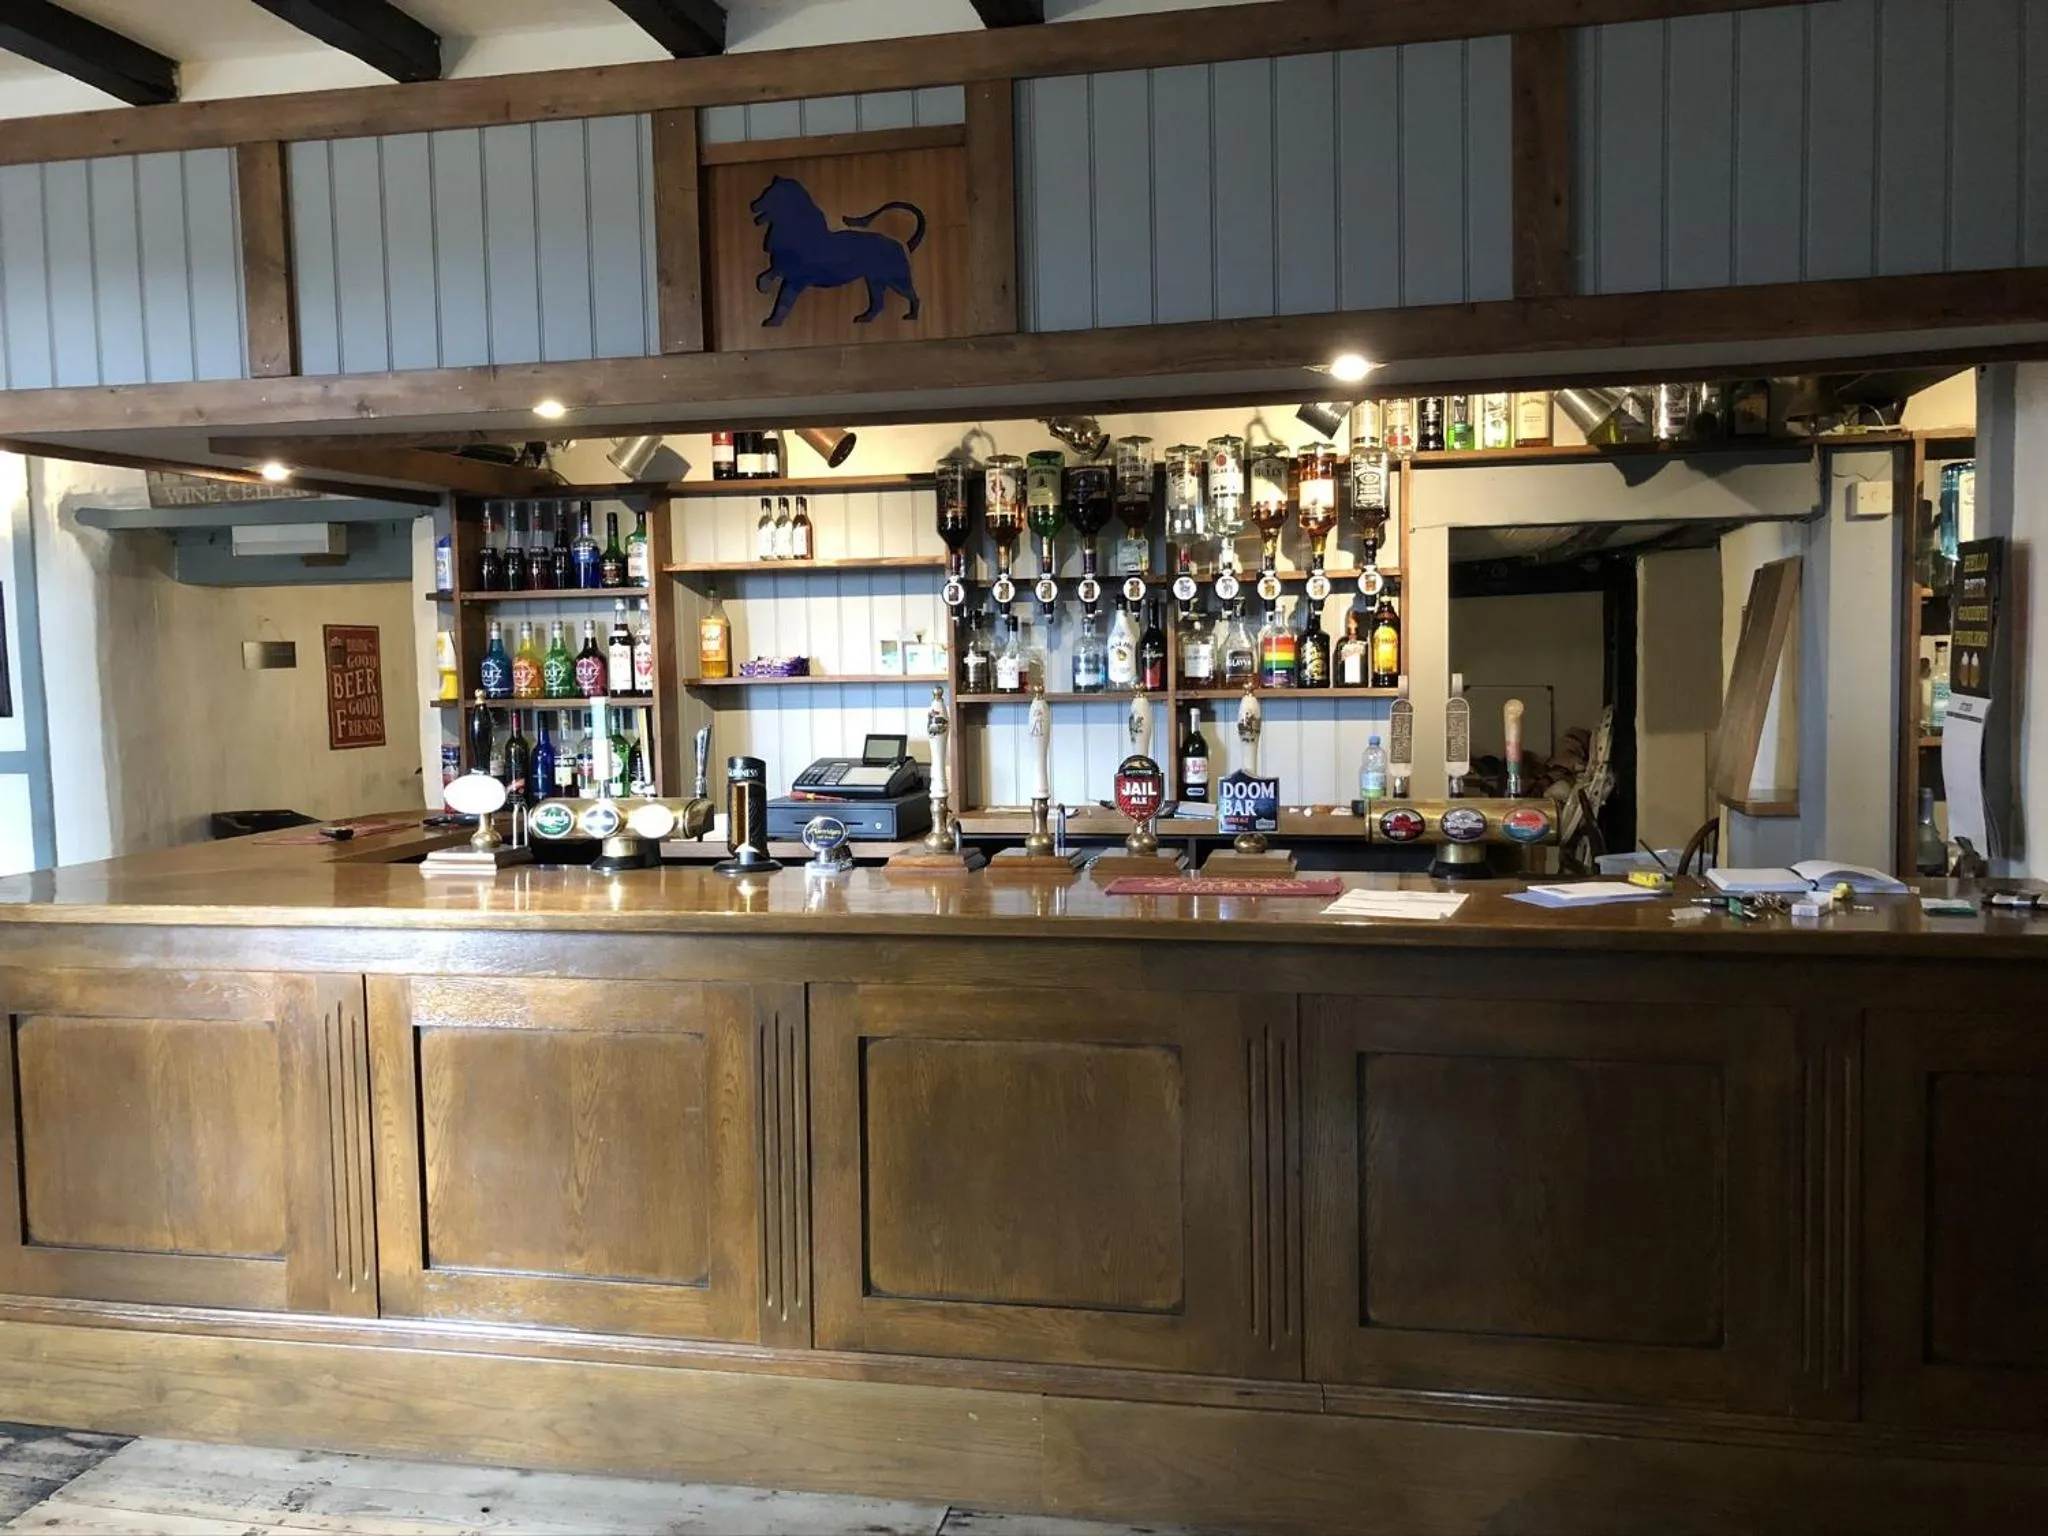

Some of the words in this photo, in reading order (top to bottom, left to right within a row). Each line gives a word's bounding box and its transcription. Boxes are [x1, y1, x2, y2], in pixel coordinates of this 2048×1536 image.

[164, 483, 222, 504] WINE
[346, 655, 377, 669] GOOD
[332, 668, 377, 699] BEER
[348, 696, 378, 717] GOOD
[336, 708, 382, 738] FRIENDS
[1121, 781, 1157, 796] JAIL
[1222, 781, 1275, 800] DOOM
[1130, 796, 1148, 805] ALE
[1222, 800, 1257, 816] BAR
